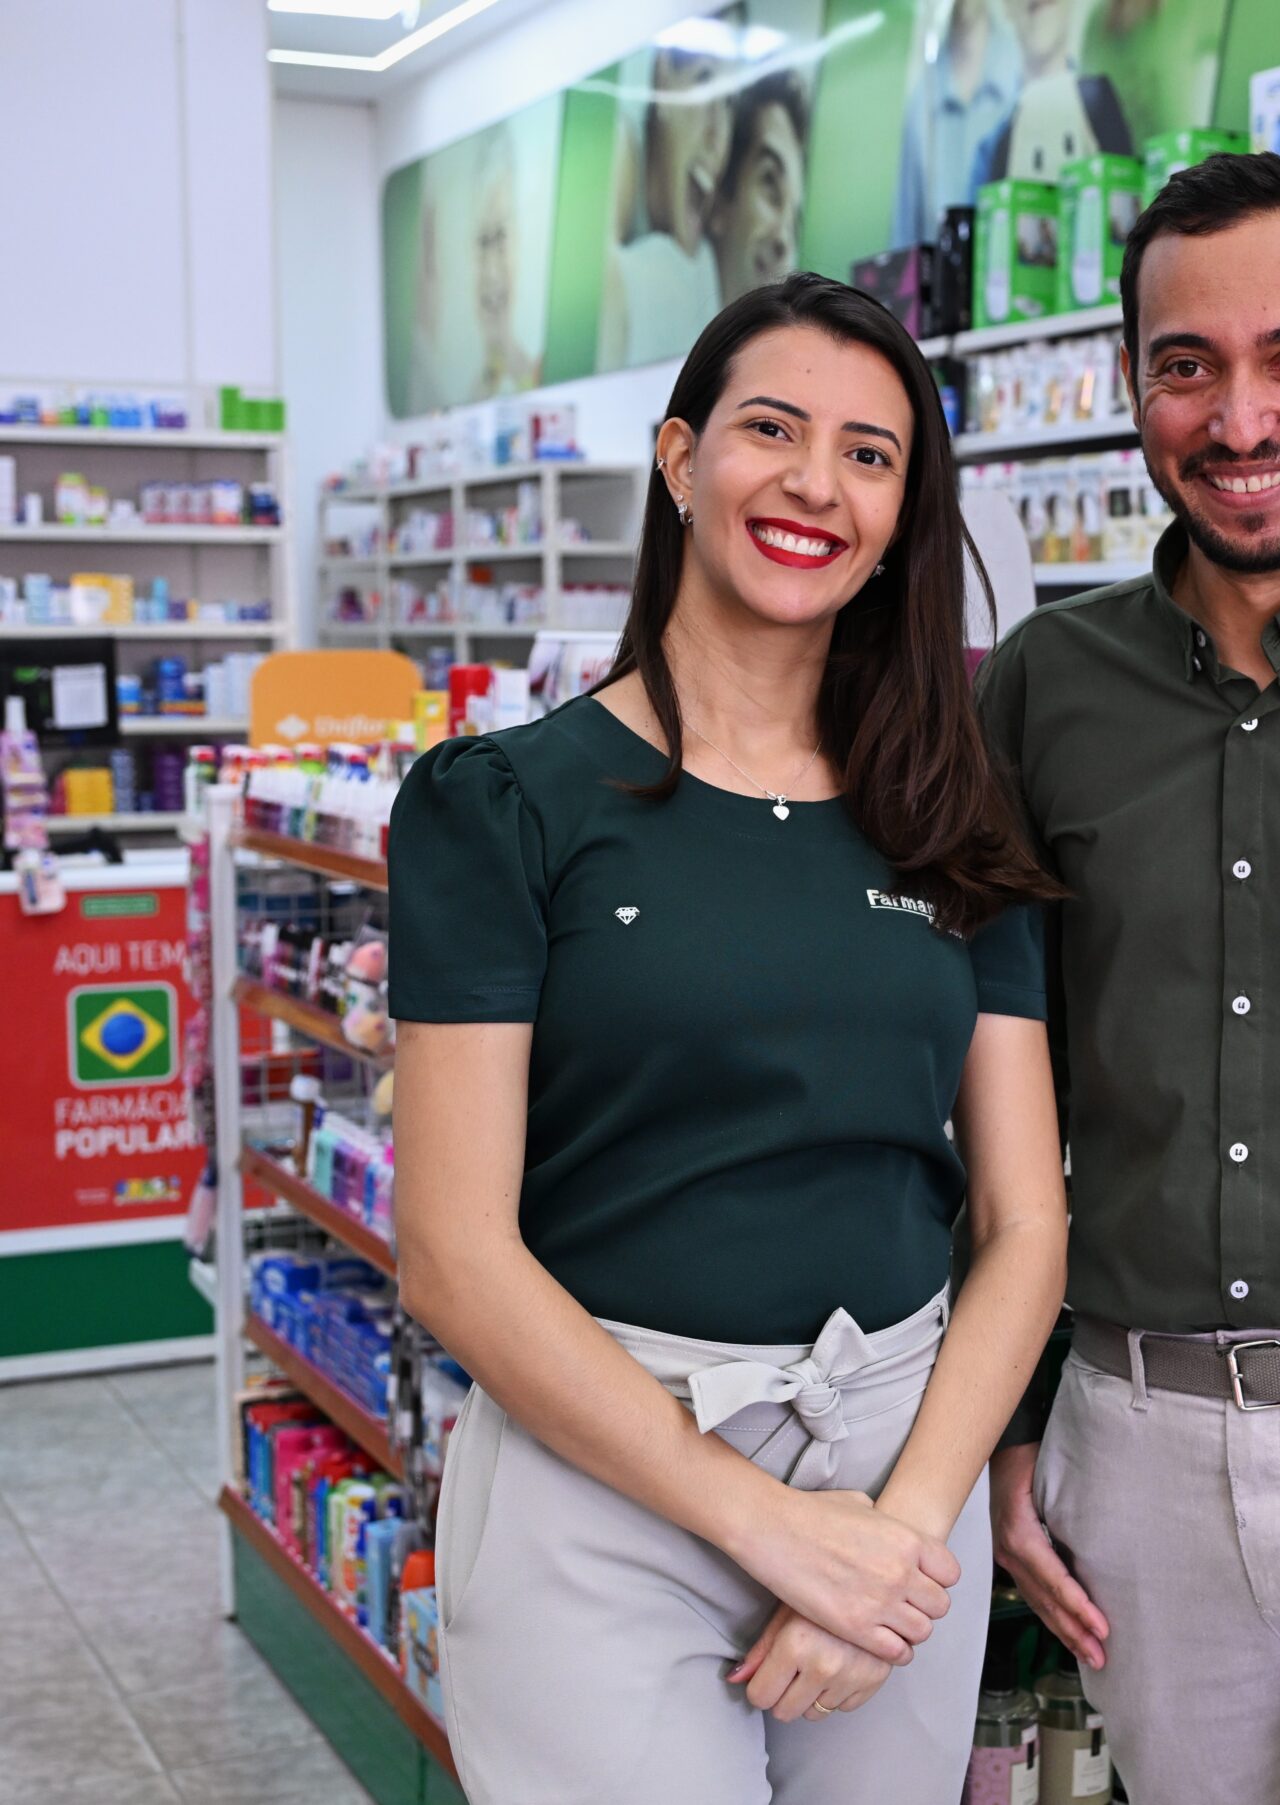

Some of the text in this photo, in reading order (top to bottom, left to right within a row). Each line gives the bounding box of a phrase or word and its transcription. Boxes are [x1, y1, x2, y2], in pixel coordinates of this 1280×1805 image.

[866, 889, 936, 915] Farmam
[53, 937, 187, 976] AQUI TEM
